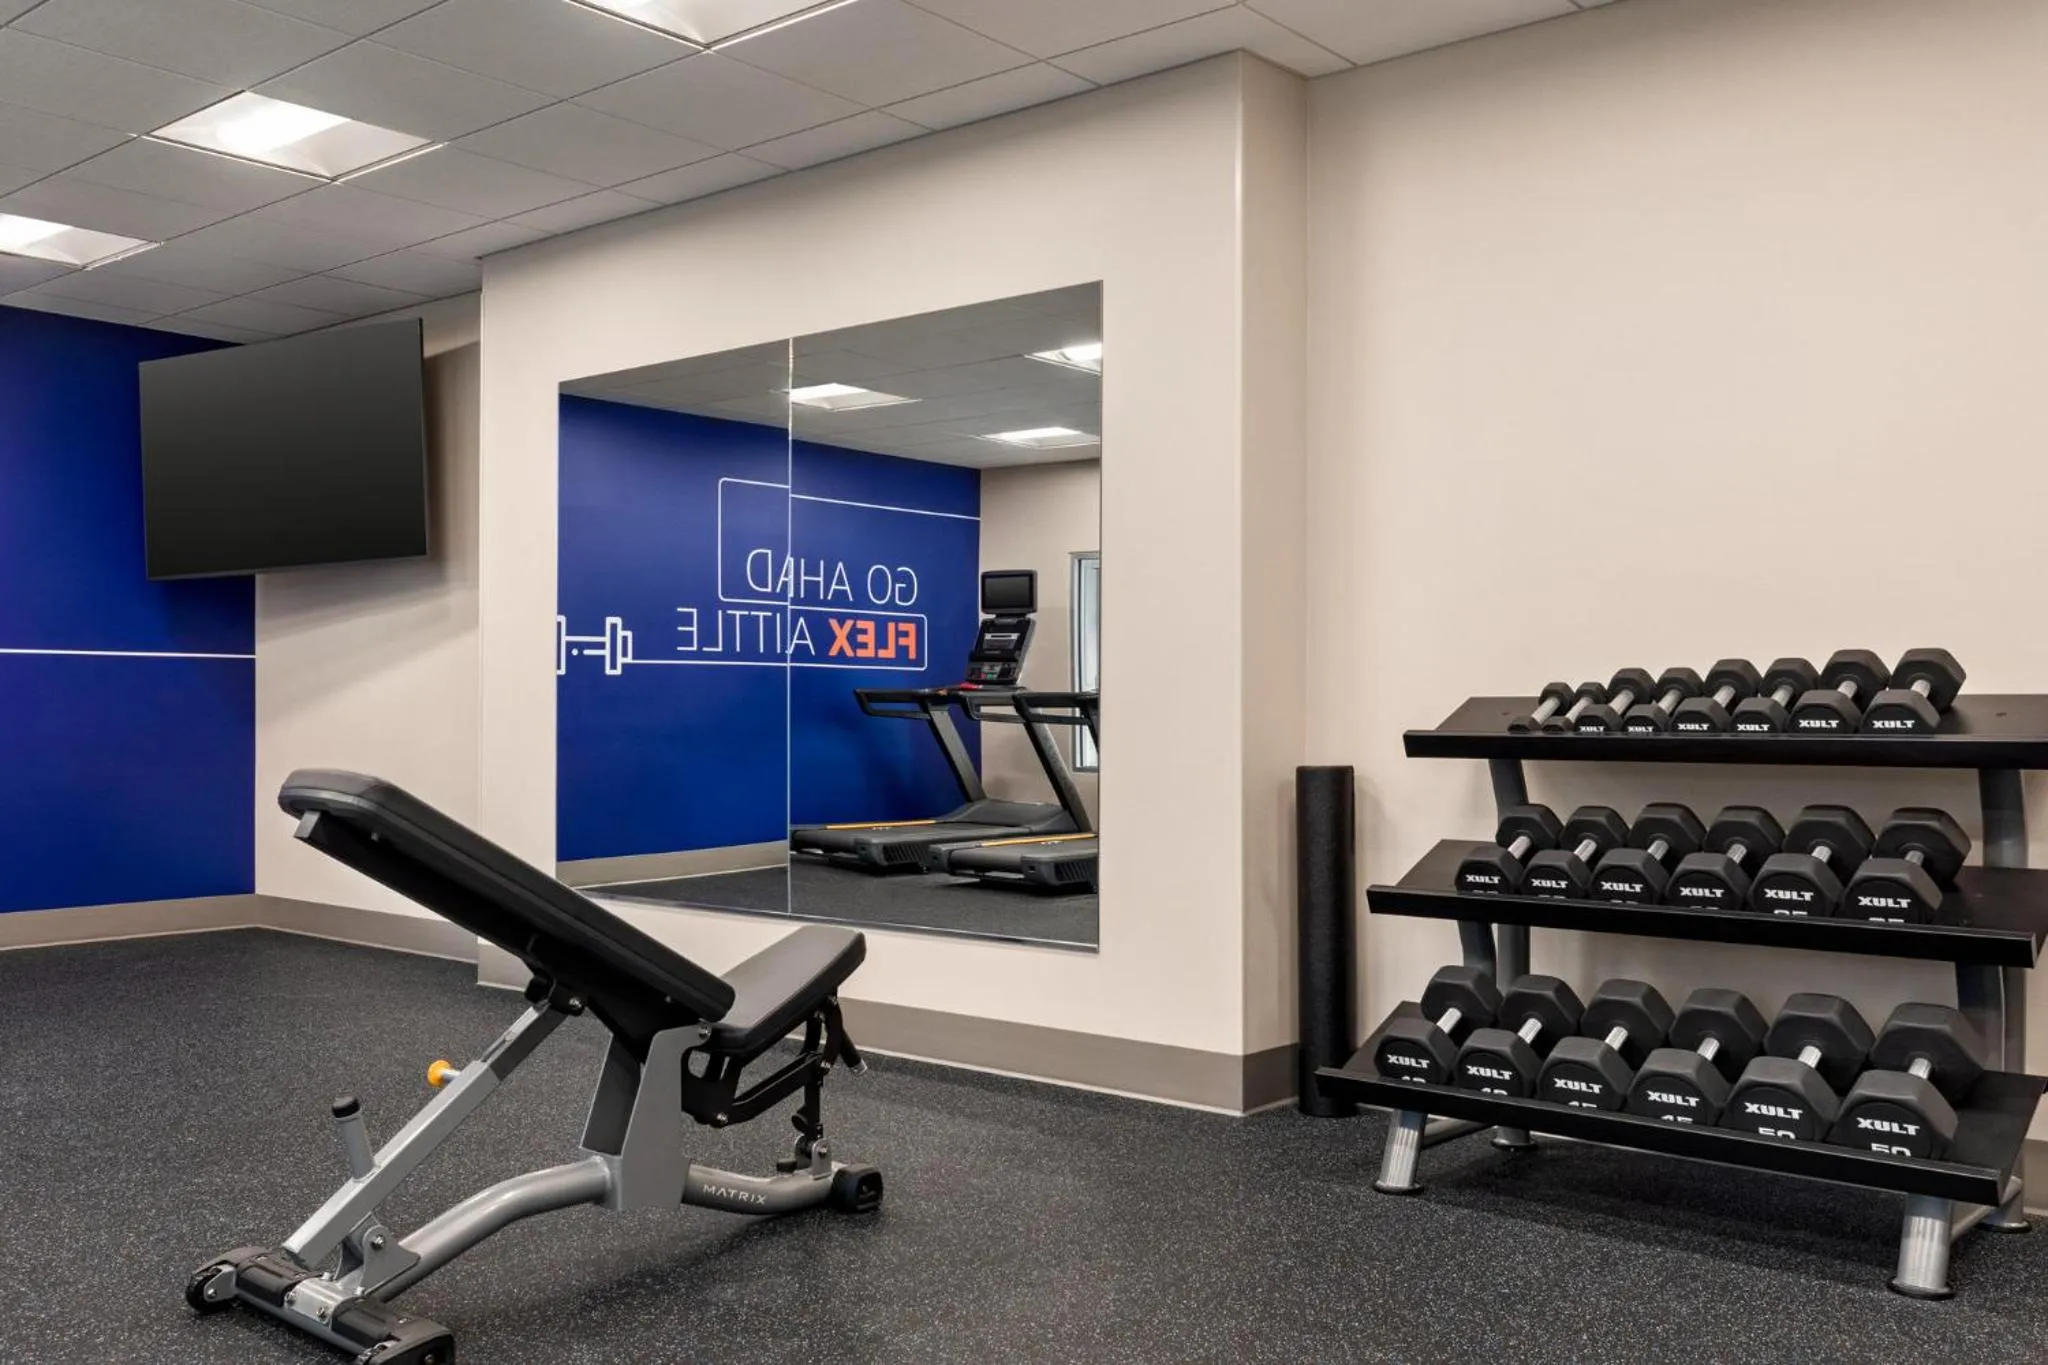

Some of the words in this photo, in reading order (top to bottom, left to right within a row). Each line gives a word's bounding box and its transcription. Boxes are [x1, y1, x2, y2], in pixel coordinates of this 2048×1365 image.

[1677, 723, 1709, 731] XULT
[1737, 723, 1770, 731] XULT
[1799, 719, 1840, 728] XULT
[1872, 720, 1915, 729] XULT
[1465, 874, 1500, 884] XULT
[1531, 878, 1569, 889] XULT
[1600, 881, 1644, 893] XULT
[1680, 887, 1725, 899] XULT
[1765, 889, 1814, 902] XULT
[1857, 896, 1912, 909] XULT
[1387, 1054, 1430, 1069] XULT
[1466, 1065, 1513, 1081] XULT
[1553, 1077, 1603, 1094] XULT
[1646, 1090, 1700, 1107] XULT
[1744, 1102, 1804, 1120] XULT
[1857, 1117, 1920, 1136] XULT
[702, 1183, 766, 1205] MATRIX
